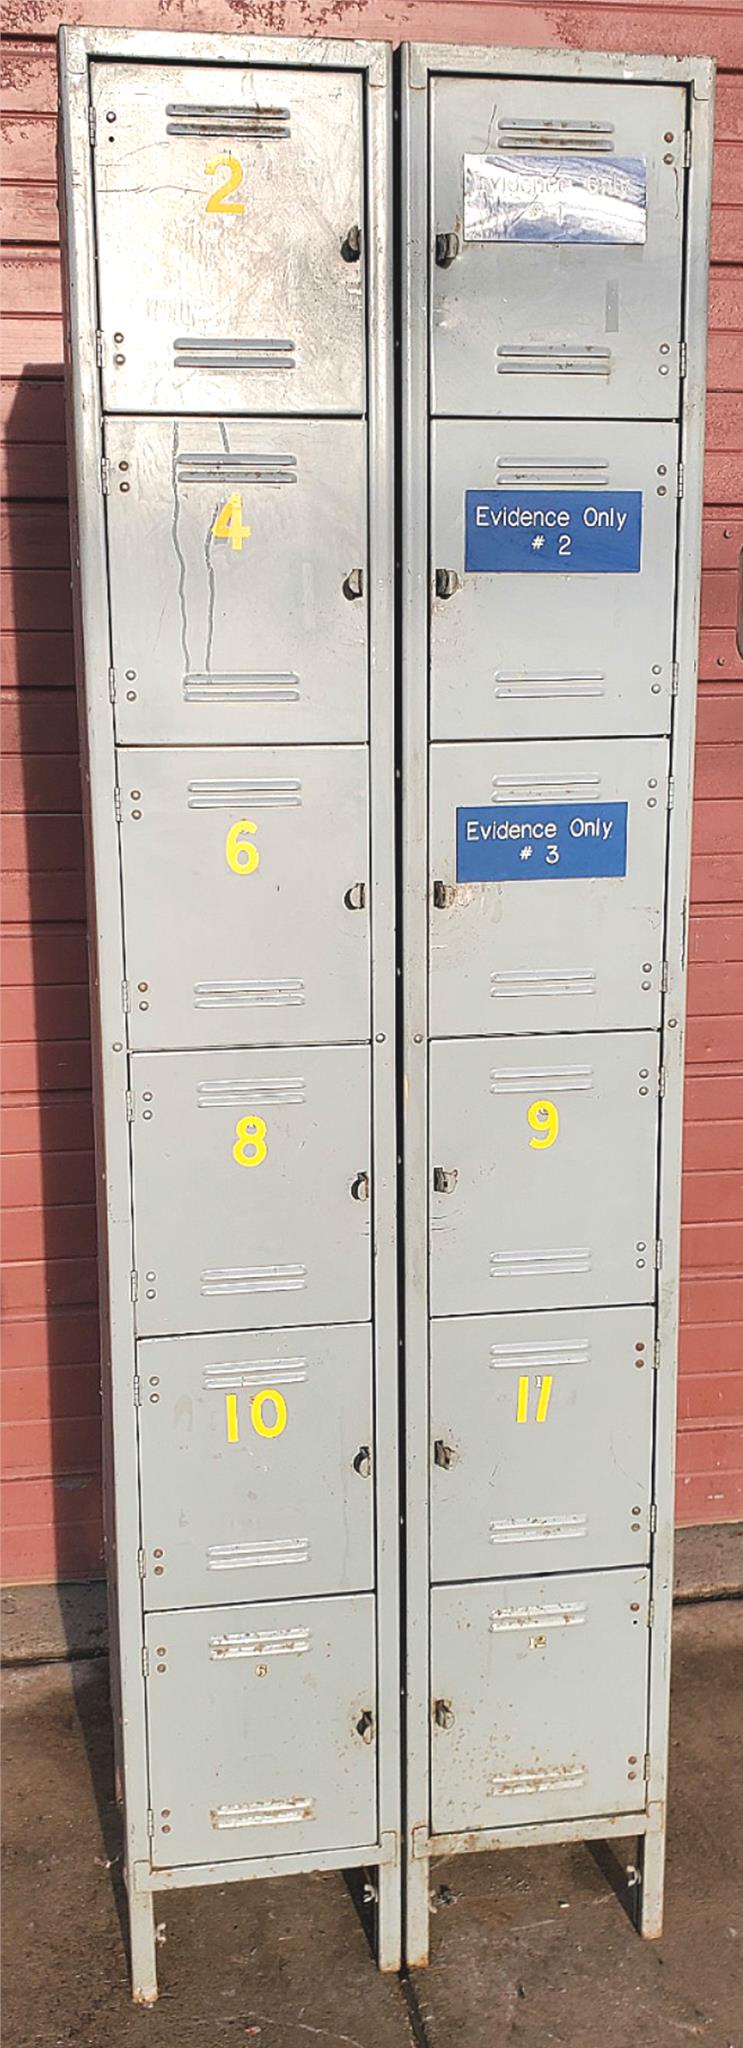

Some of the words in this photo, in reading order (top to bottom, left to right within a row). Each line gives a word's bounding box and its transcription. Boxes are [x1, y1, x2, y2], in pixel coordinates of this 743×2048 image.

[204, 154, 245, 213] 2
[211, 492, 251, 551] 4
[475, 505, 571, 527] Evidence
[583, 506, 628, 531] Only
[531, 535, 545, 550] #
[558, 535, 572, 556] 2
[226, 819, 260, 876] 6
[466, 820, 558, 842] Evidence
[570, 817, 613, 840] Only
[519, 846, 533, 860] #
[545, 845, 560, 864] 3
[233, 1115, 268, 1168] 8
[527, 1100, 559, 1150] 9
[225, 1388, 288, 1443] 10
[516, 1375, 553, 1424] 11
